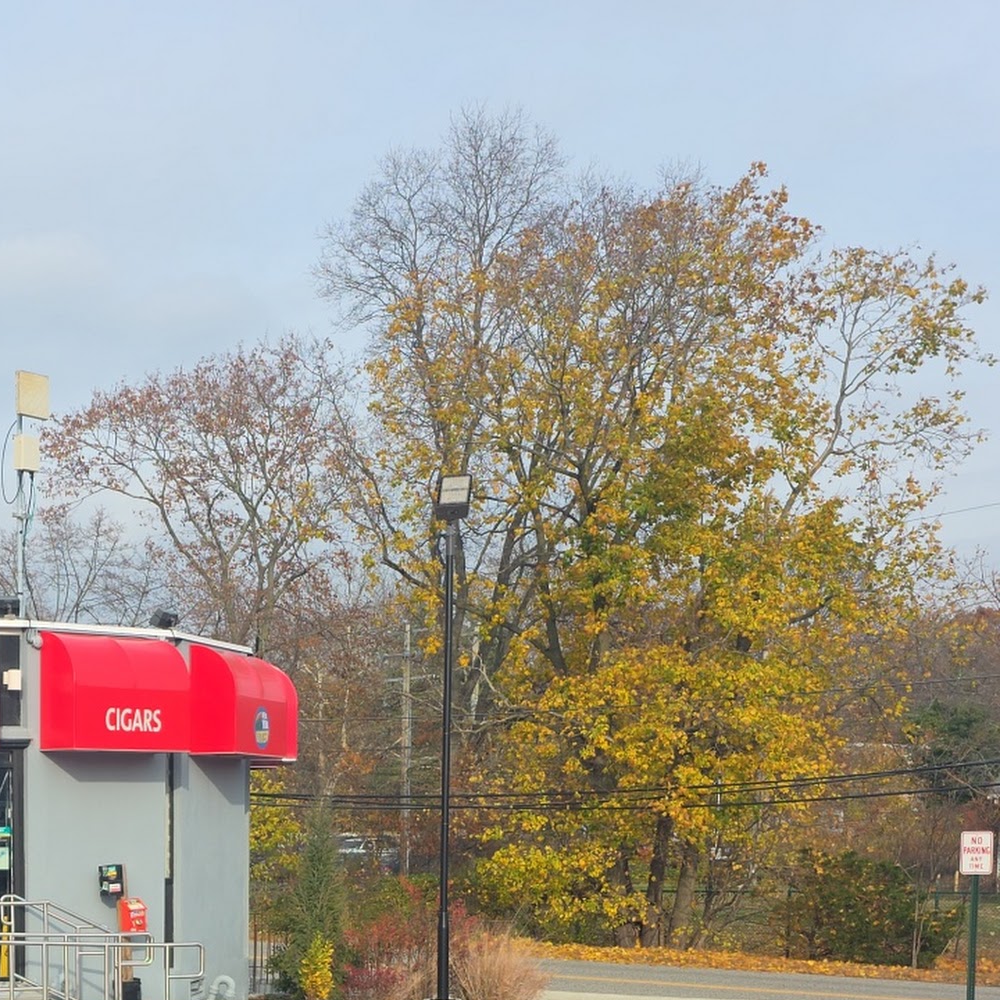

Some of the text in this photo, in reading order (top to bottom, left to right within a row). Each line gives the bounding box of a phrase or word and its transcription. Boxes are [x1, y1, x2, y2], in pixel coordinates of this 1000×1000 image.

[105, 707, 162, 732] CIGARS
[971, 836, 983, 845] NO
[963, 846, 991, 855] PARKING
